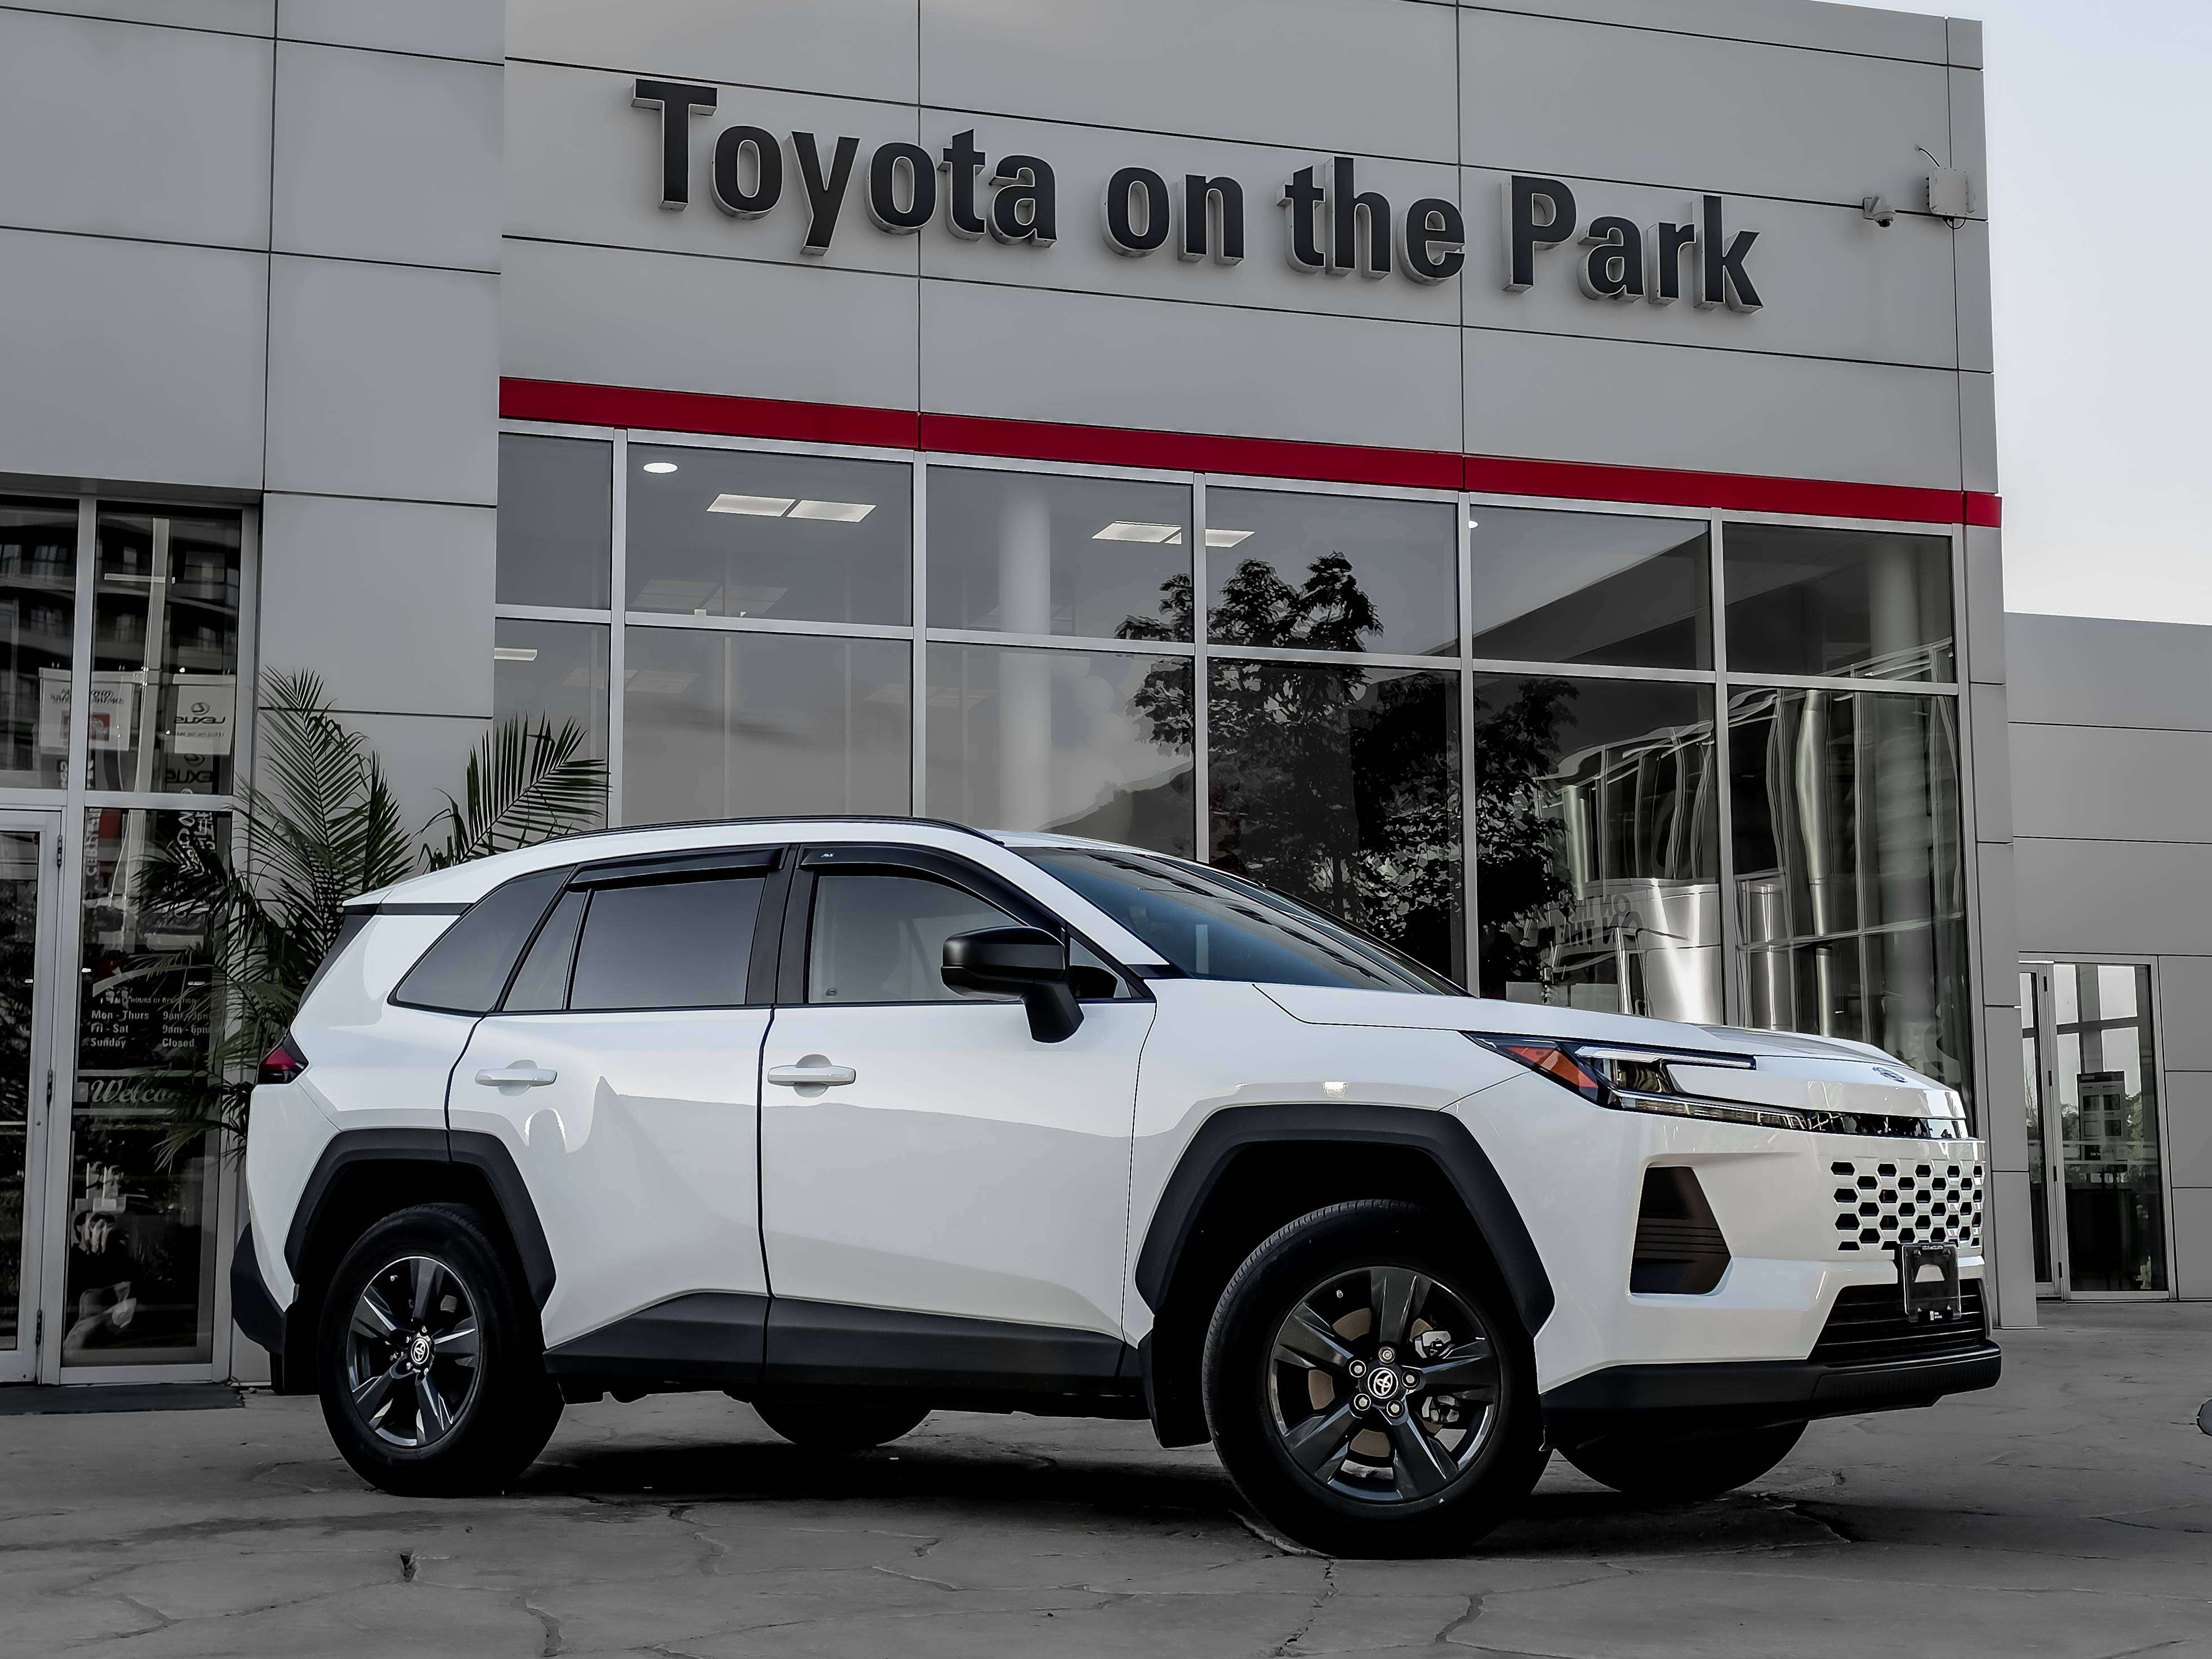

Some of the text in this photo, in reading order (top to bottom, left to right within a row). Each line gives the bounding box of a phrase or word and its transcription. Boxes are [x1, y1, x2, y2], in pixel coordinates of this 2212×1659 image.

[633, 78, 1761, 310] Toyota on the Park
[91, 1009, 113, 1020] Mon
[122, 1010, 149, 1020] Thurs
[91, 1023, 103, 1033] Fri
[113, 1024, 129, 1033] Sat
[90, 1037, 195, 1049] Sunday Closed
[90, 1078, 181, 1103] Welco
